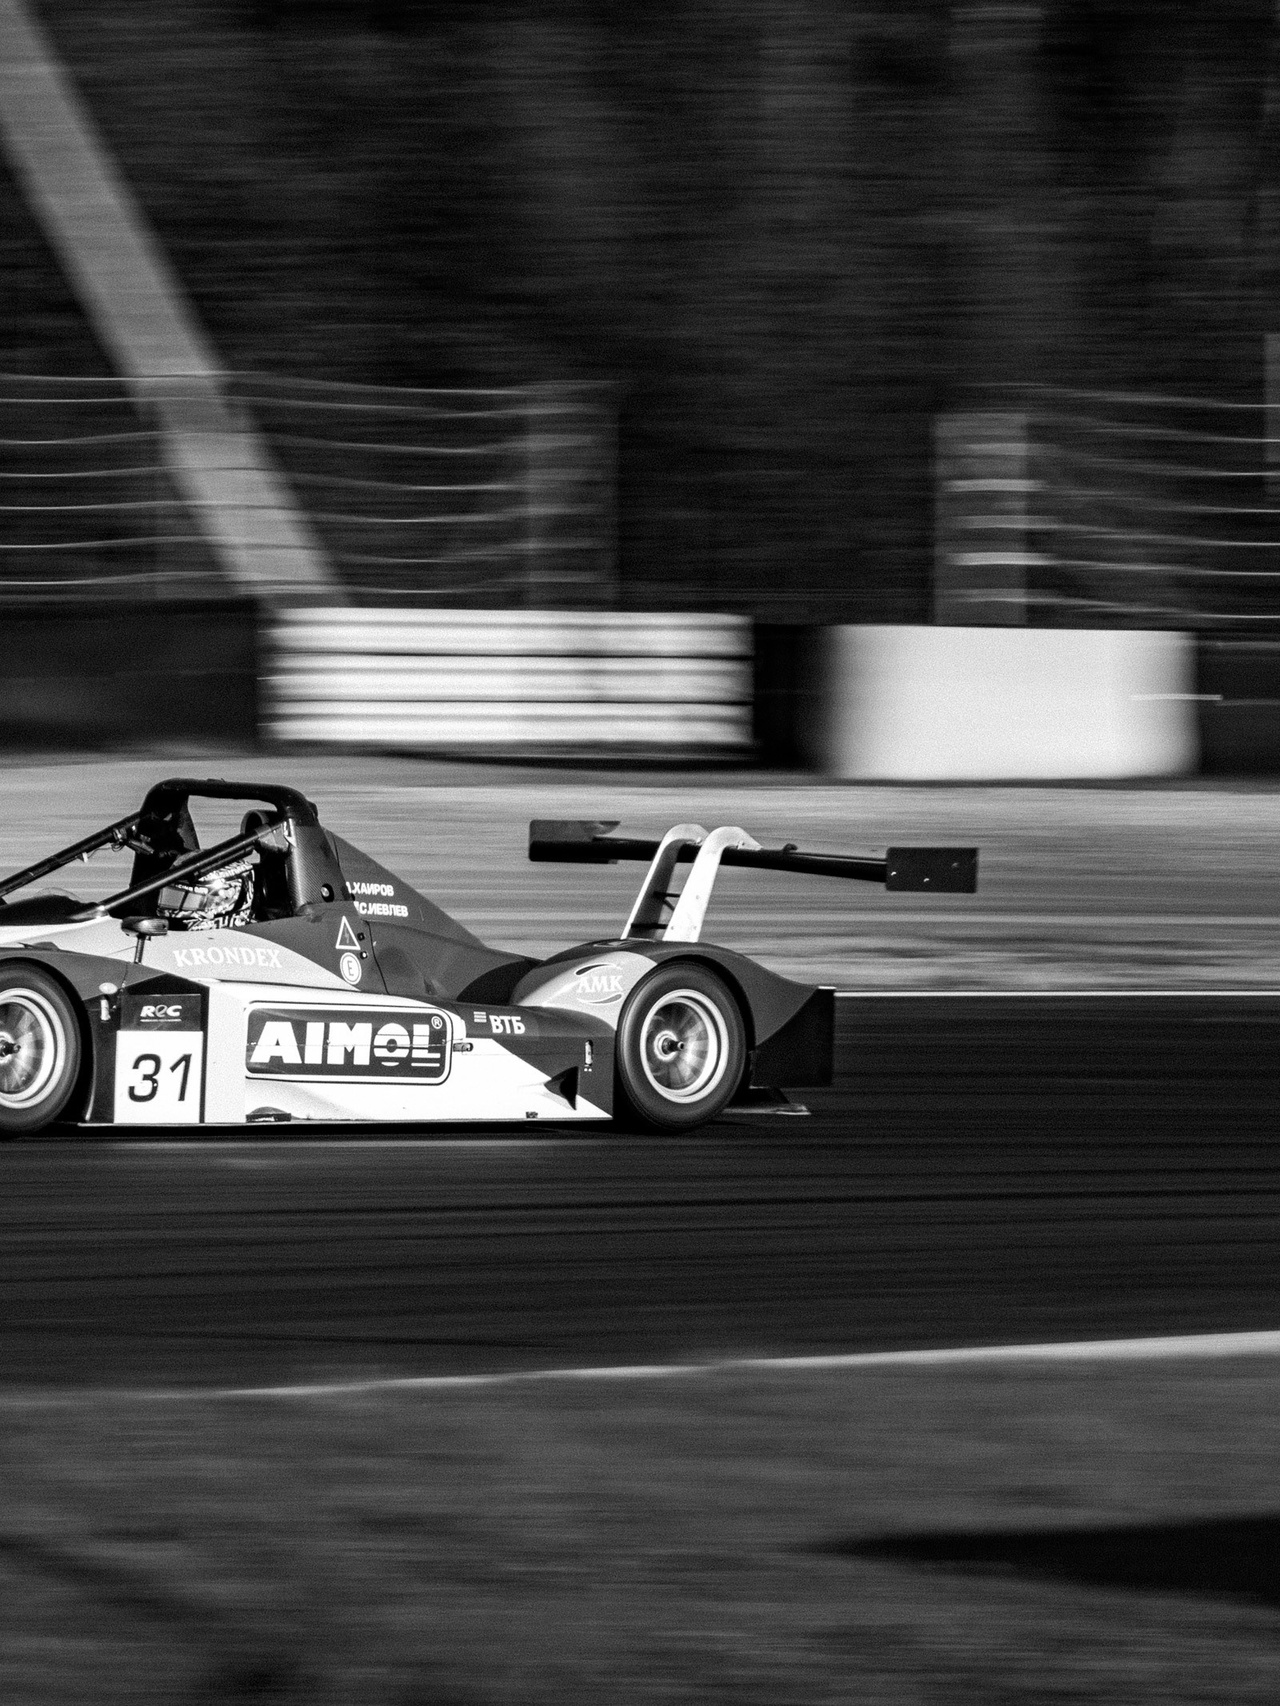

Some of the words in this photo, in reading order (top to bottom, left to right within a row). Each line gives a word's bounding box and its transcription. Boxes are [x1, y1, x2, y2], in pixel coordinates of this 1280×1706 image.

[173, 946, 282, 968] KRONDEX
[488, 1014, 526, 1035] ВТБ
[249, 1021, 441, 1067] AIMOL
[128, 1053, 193, 1103] 31
